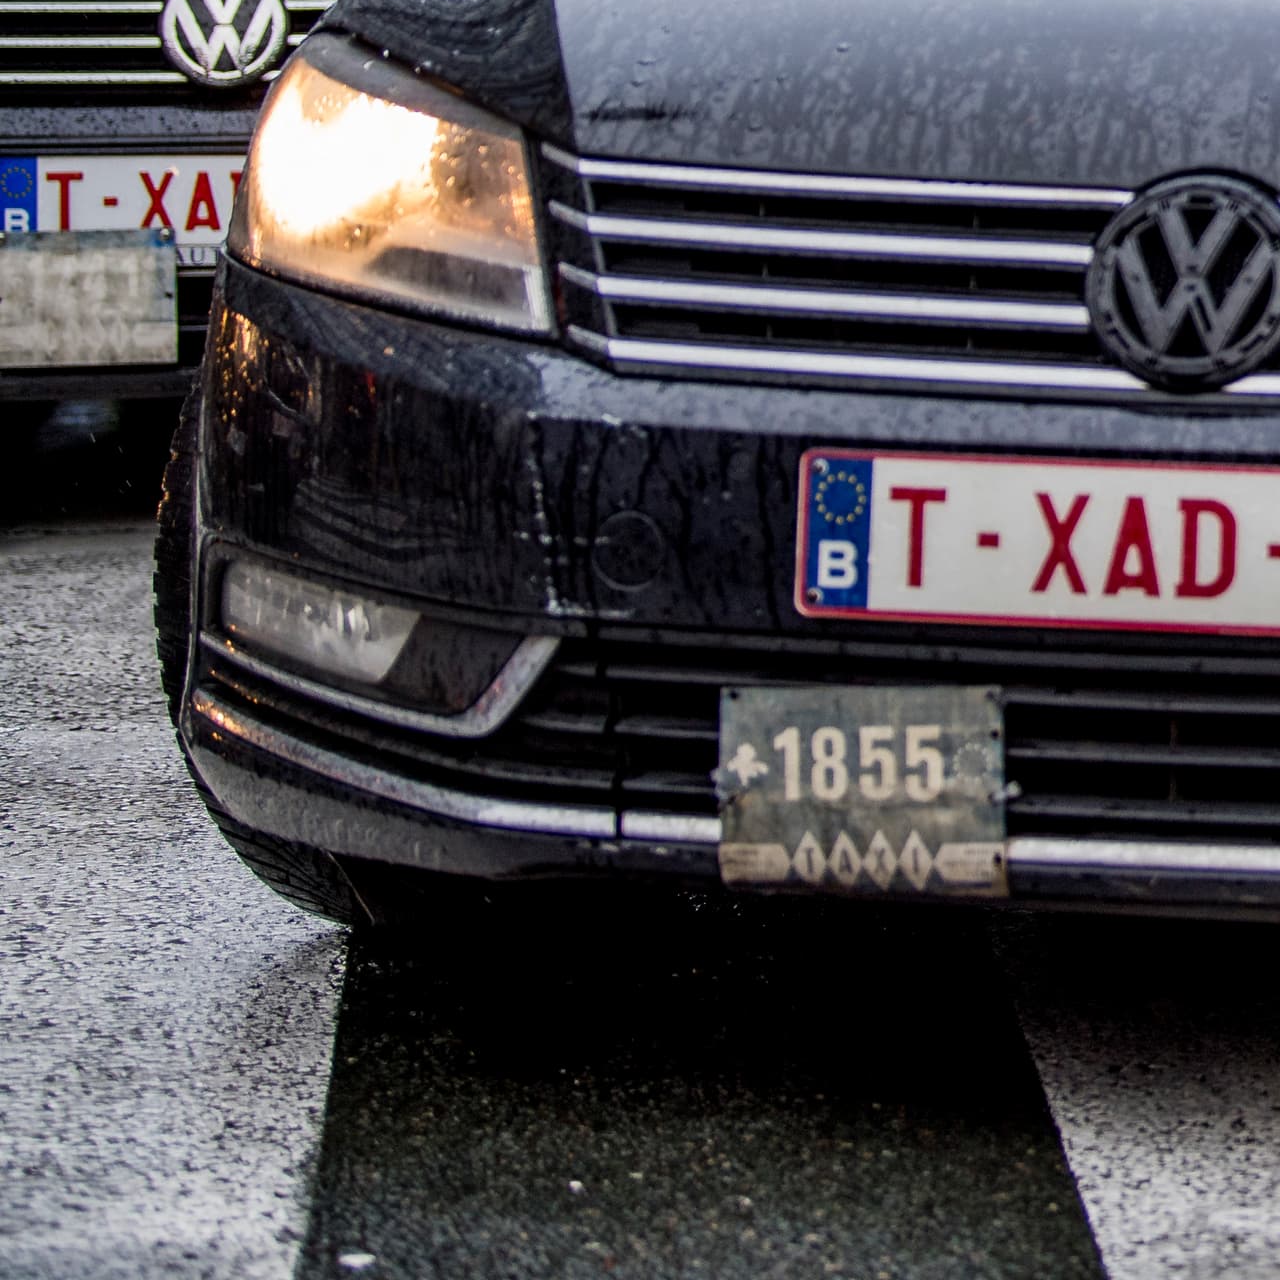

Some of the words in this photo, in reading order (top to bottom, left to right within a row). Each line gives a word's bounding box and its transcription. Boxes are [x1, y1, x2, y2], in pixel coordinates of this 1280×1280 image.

[815, 540, 858, 589] B
[773, 725, 945, 801] 1855
[801, 846, 921, 875] TAXI
